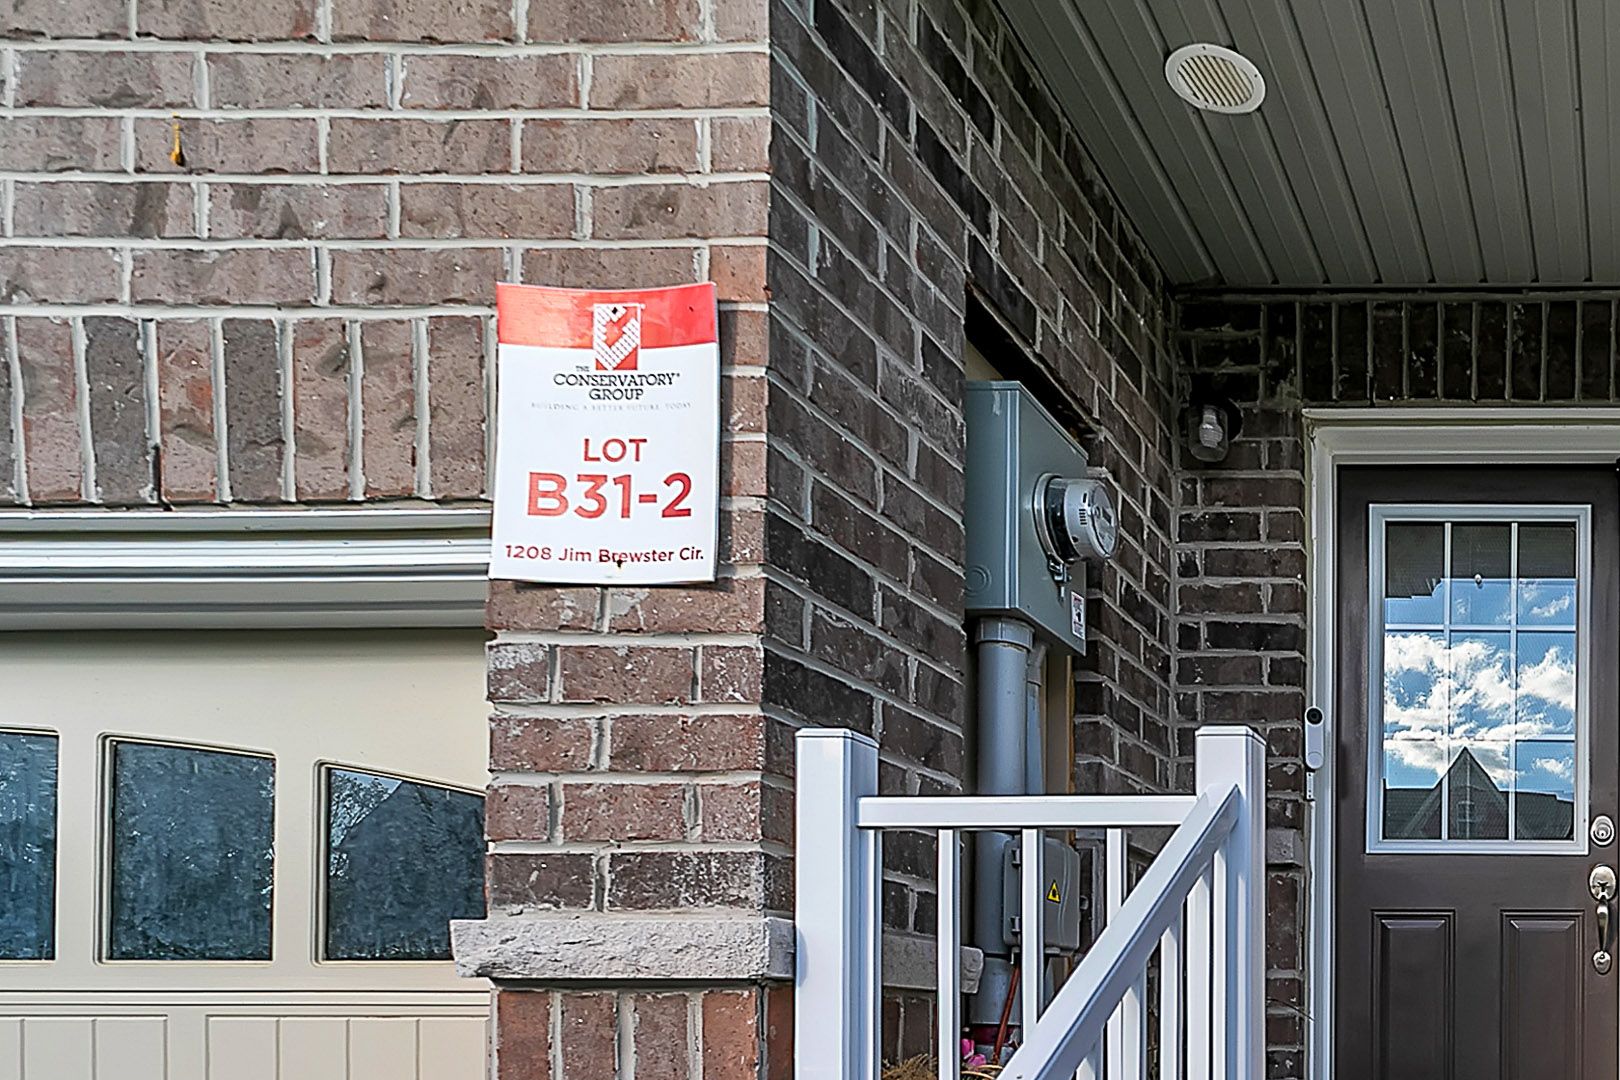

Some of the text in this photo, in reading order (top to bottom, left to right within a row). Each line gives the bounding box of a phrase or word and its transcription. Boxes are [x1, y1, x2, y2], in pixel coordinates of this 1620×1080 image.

[553, 373, 676, 387] CONSERVATORY
[589, 388, 644, 400] GROUP
[584, 438, 648, 462] LOT
[527, 471, 692, 519] B31-2
[505, 544, 704, 563] 1208 Jim Brewster Cir.
